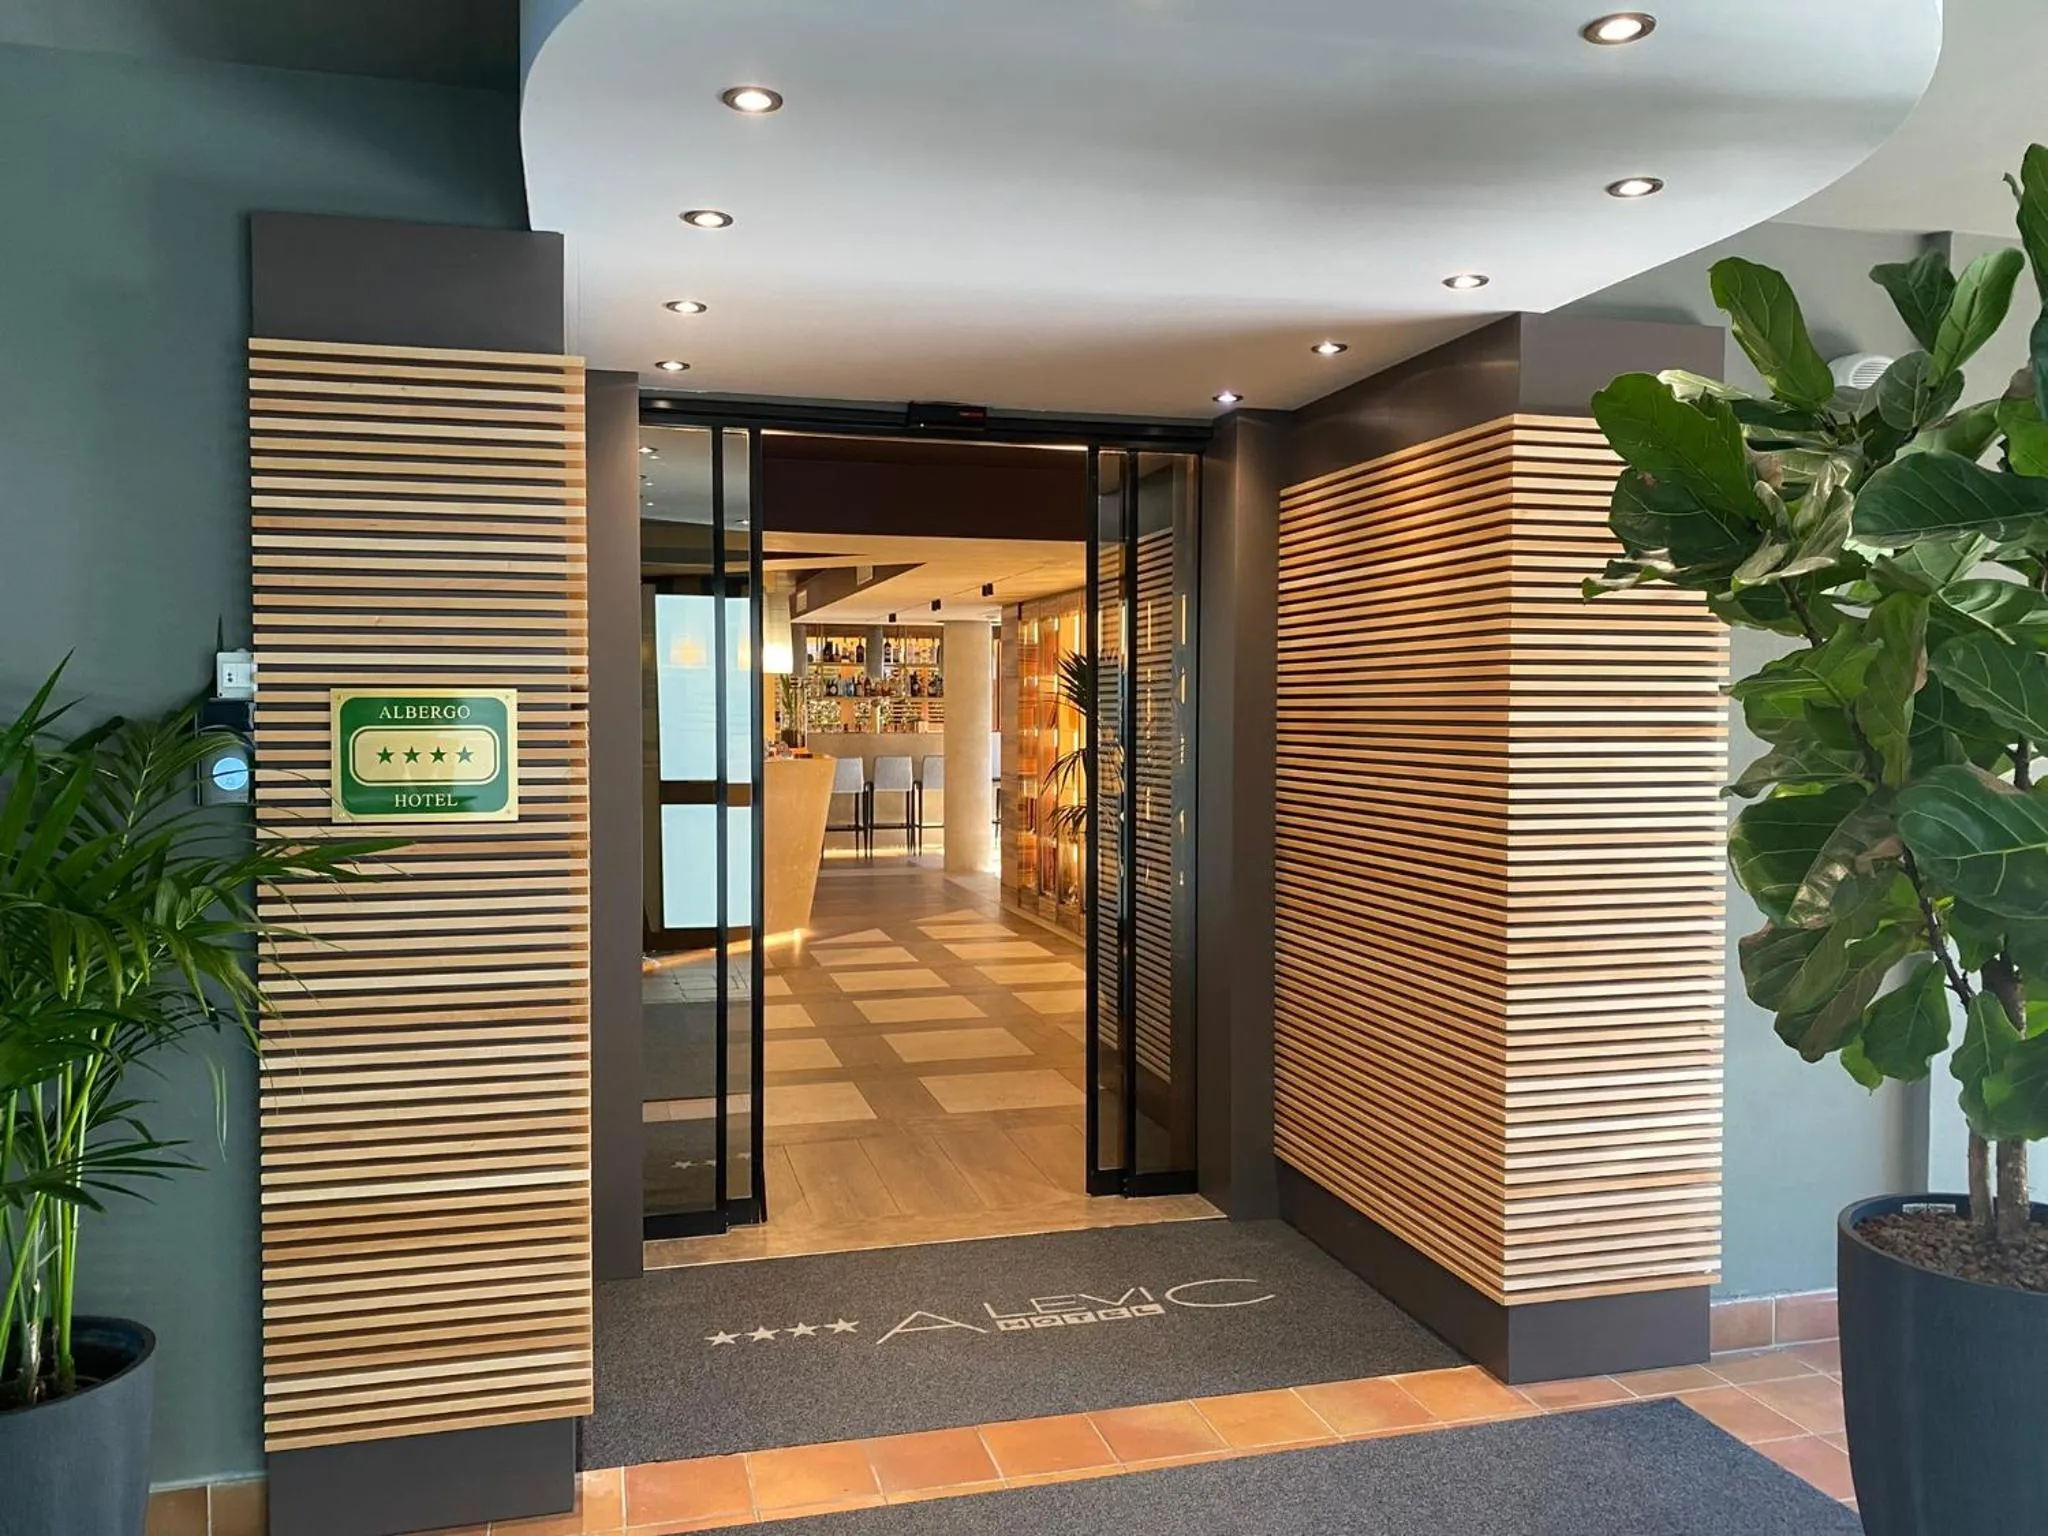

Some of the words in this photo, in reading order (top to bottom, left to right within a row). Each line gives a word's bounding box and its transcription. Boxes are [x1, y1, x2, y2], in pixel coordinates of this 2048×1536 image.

[379, 705, 471, 719] ALBERGO
[395, 793, 458, 808] HOTEL
[876, 1278, 1276, 1345] ALEVIC
[997, 1304, 1165, 1331] HOTEL
